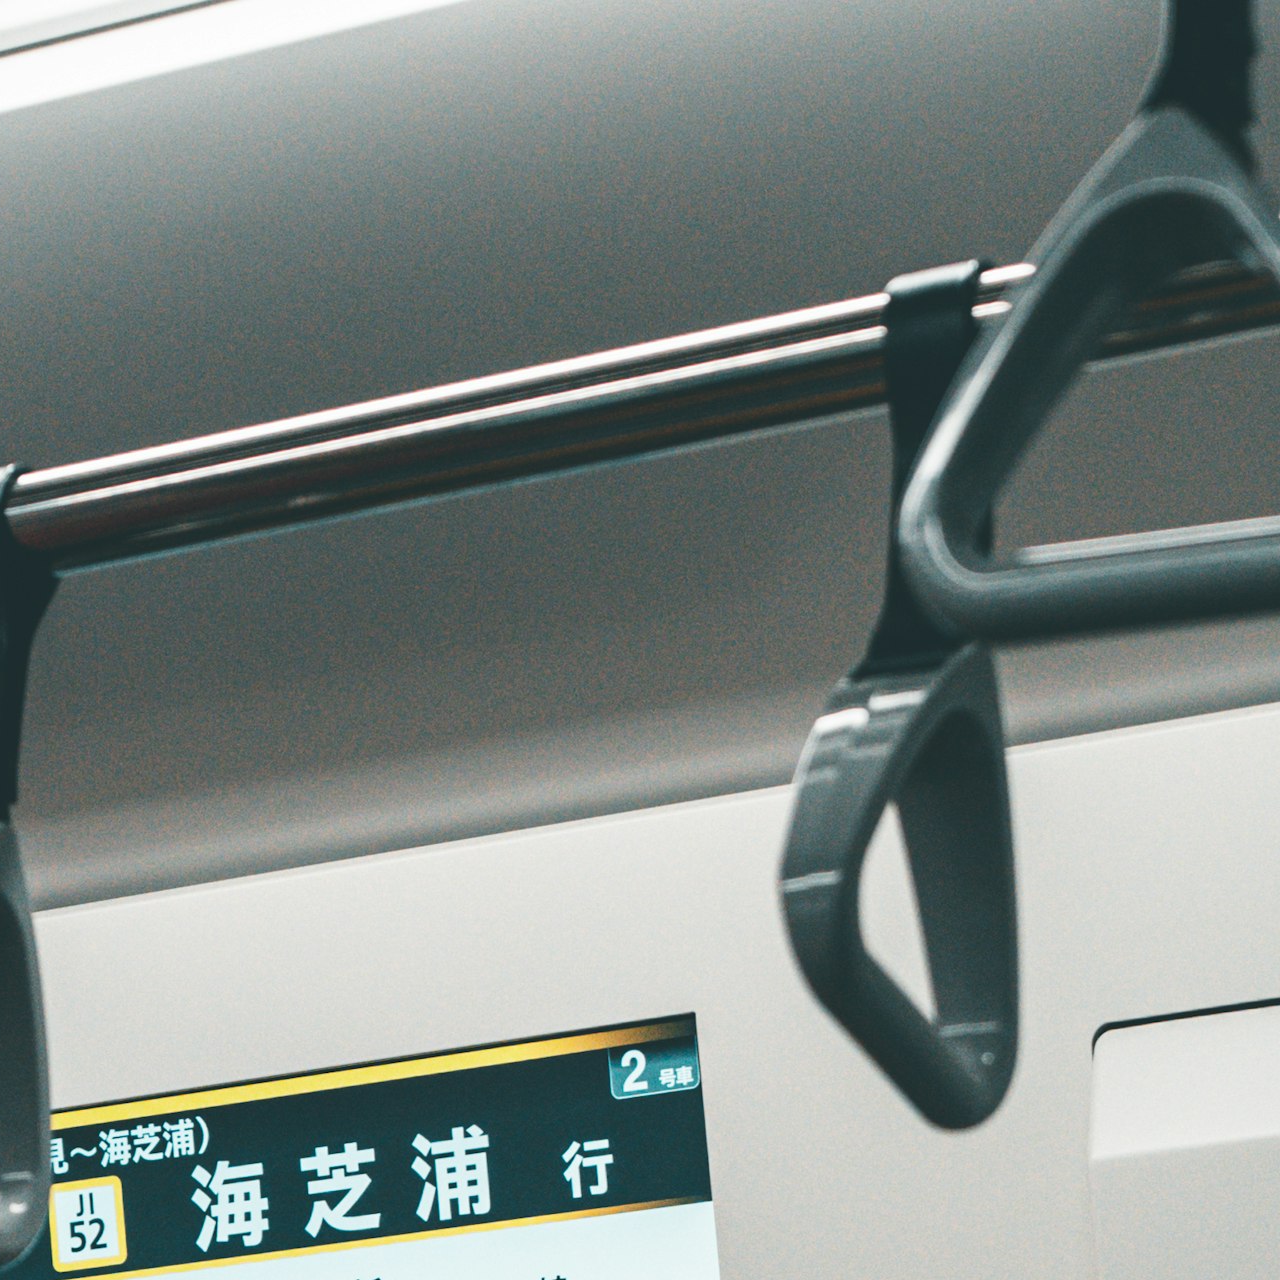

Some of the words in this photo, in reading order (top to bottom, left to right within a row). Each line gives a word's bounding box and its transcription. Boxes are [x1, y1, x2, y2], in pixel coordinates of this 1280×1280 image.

[621, 1049, 649, 1093] 2
[658, 1065, 695, 1089] 号車
[76, 1192, 96, 1217] JI
[190, 1124, 493, 1253] 海芝浦
[562, 1138, 614, 1199] 行
[69, 1218, 108, 1253] 52
